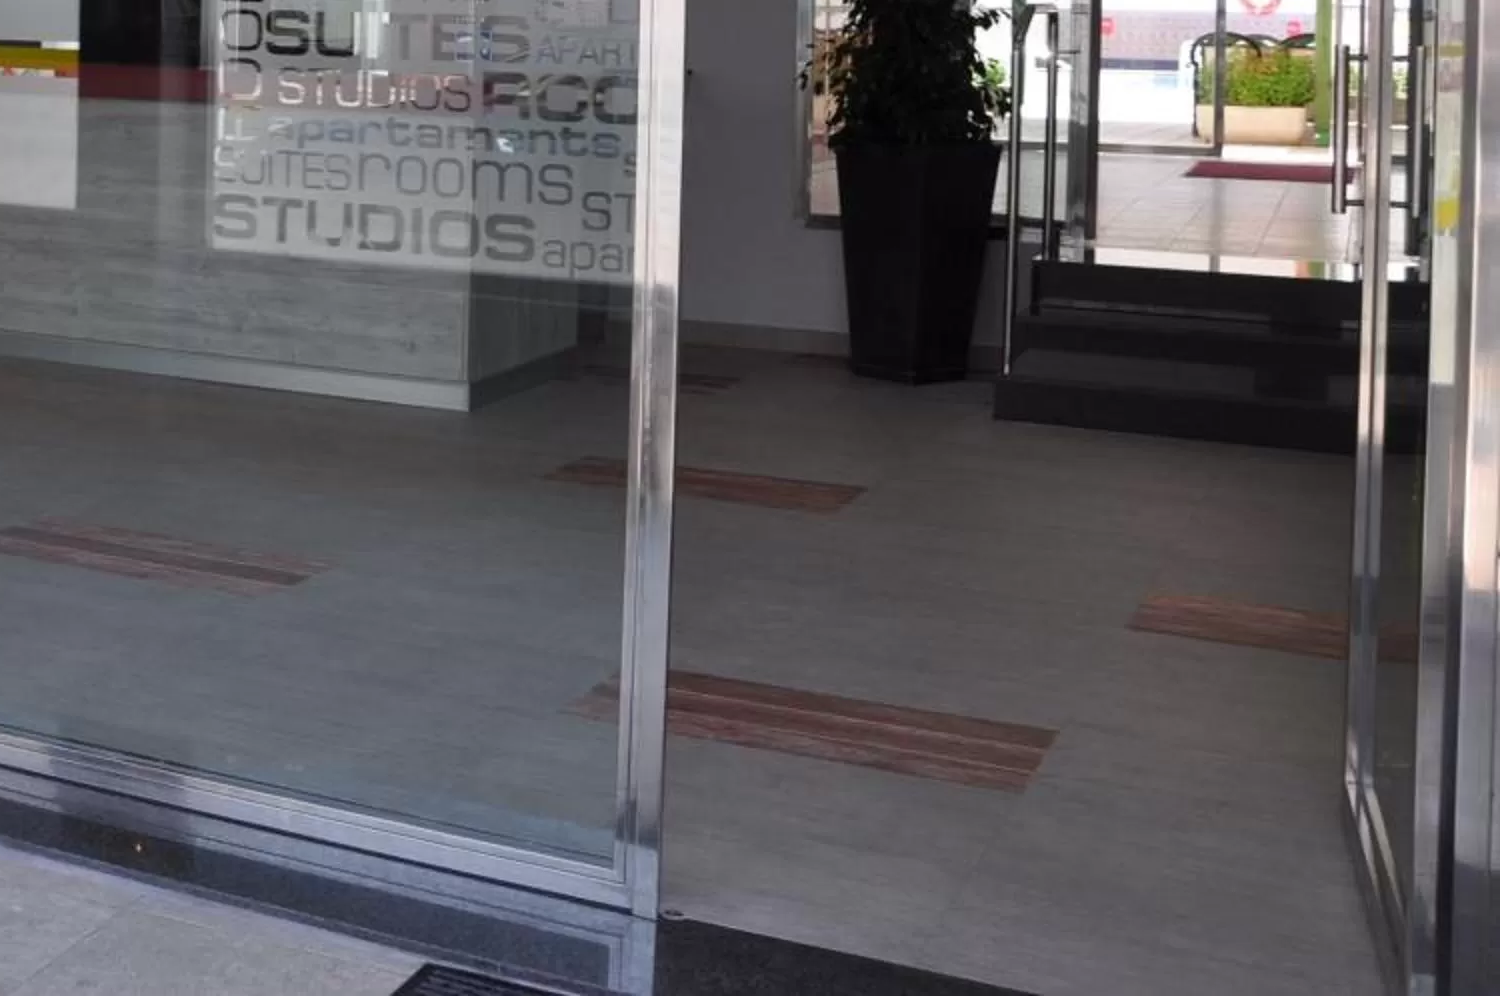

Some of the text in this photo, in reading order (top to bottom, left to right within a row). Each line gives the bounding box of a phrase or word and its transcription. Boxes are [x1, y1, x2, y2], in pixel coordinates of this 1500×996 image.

[277, 67, 471, 112] STUDIOS
[357, 152, 574, 206] rooms
[212, 193, 535, 263] STUDIOS
